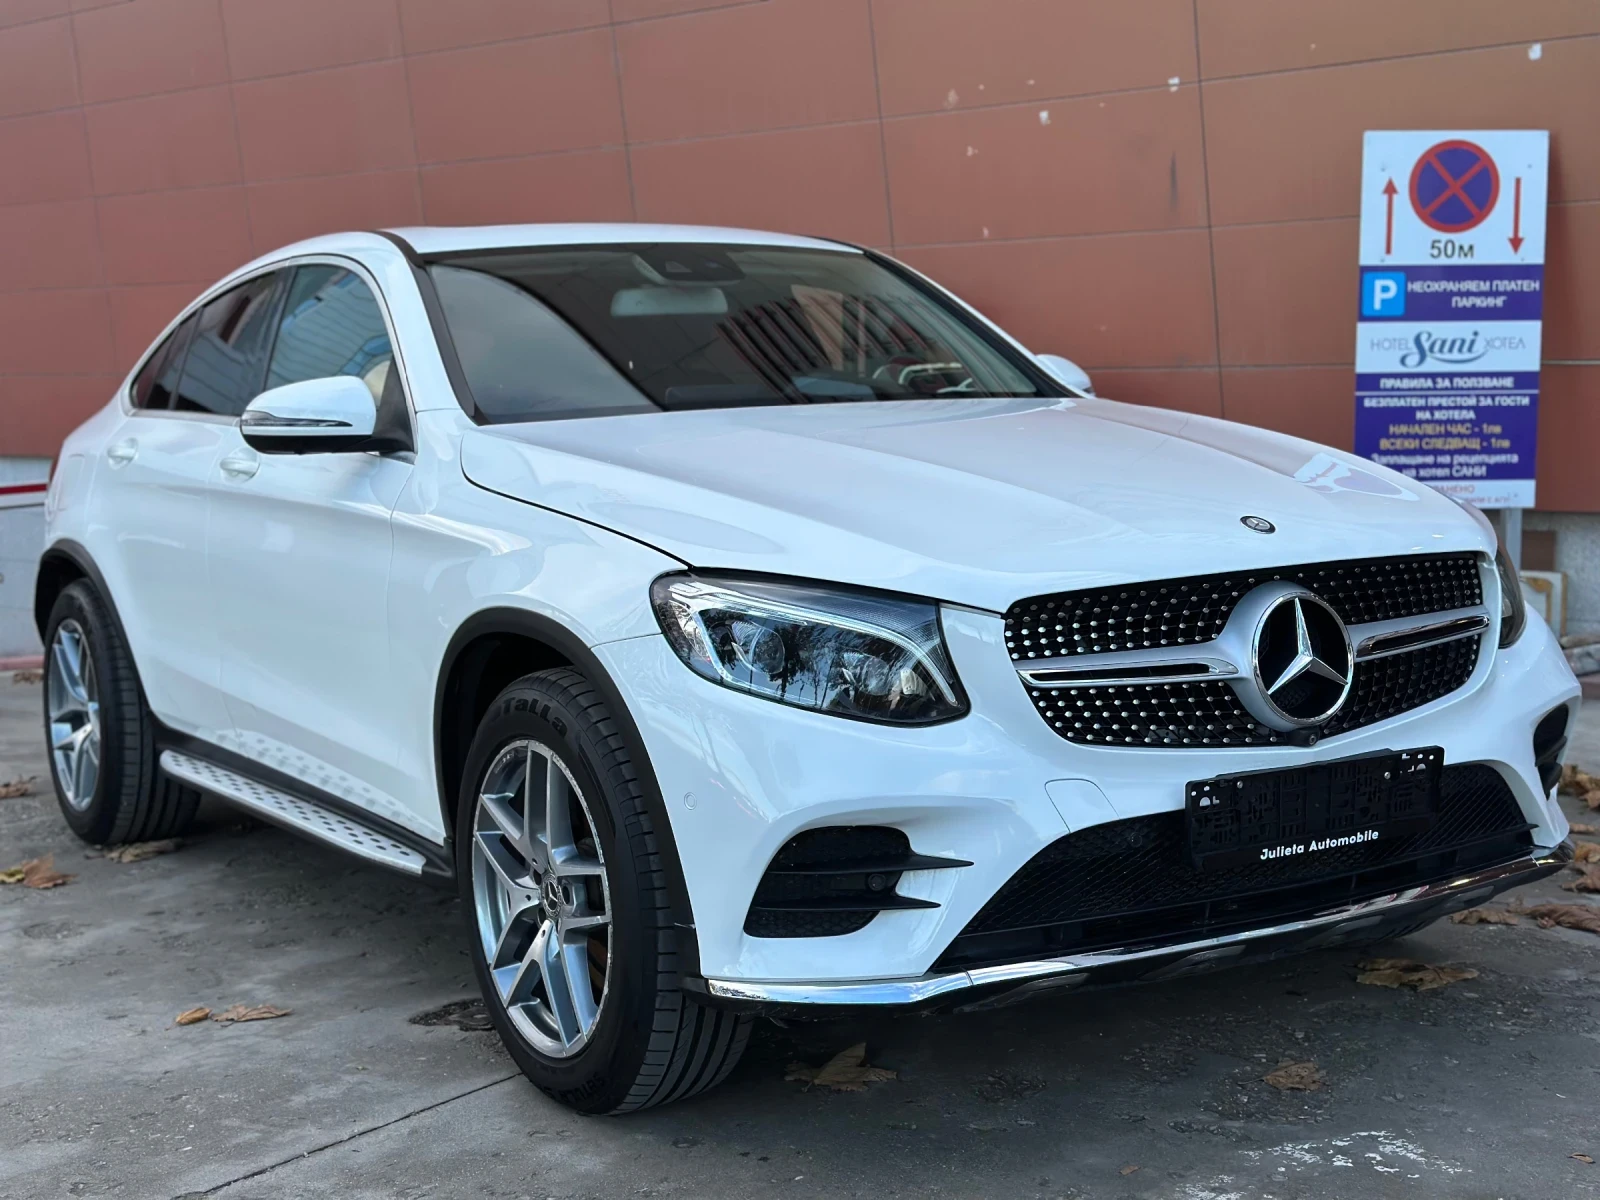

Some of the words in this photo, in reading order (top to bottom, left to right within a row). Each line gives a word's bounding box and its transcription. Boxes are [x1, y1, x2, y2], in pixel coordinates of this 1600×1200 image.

[1407, 280, 1490, 293] НЕОХРАНЯЕМ
[1492, 279, 1540, 292] ПЛАТЕН
[1373, 279, 1398, 311] P
[1451, 296, 1507, 308] ПАРКИНГ
[1370, 338, 1413, 351] HOTEL
[1399, 330, 1482, 369] Sani
[1483, 336, 1526, 350] ХОТЕЛ
[1380, 377, 1433, 389] ПРАВИЛА
[1435, 377, 1451, 389] ЗА
[1452, 376, 1515, 389] ПОЛЗВАНЕ
[1363, 397, 1426, 408] БЕЗПЛАТЕН
[1427, 394, 1477, 407] ПРЕСТОЙ
[1478, 396, 1493, 407] ЗА
[1494, 395, 1530, 407] ГОСТИ
[1416, 410, 1431, 420] НА
[1432, 409, 1476, 420] ХОТЕЛА
[1446, 423, 1472, 435] ЧАС
[1260, 844, 1304, 860] Julieta
[1308, 829, 1379, 852] Automobile
